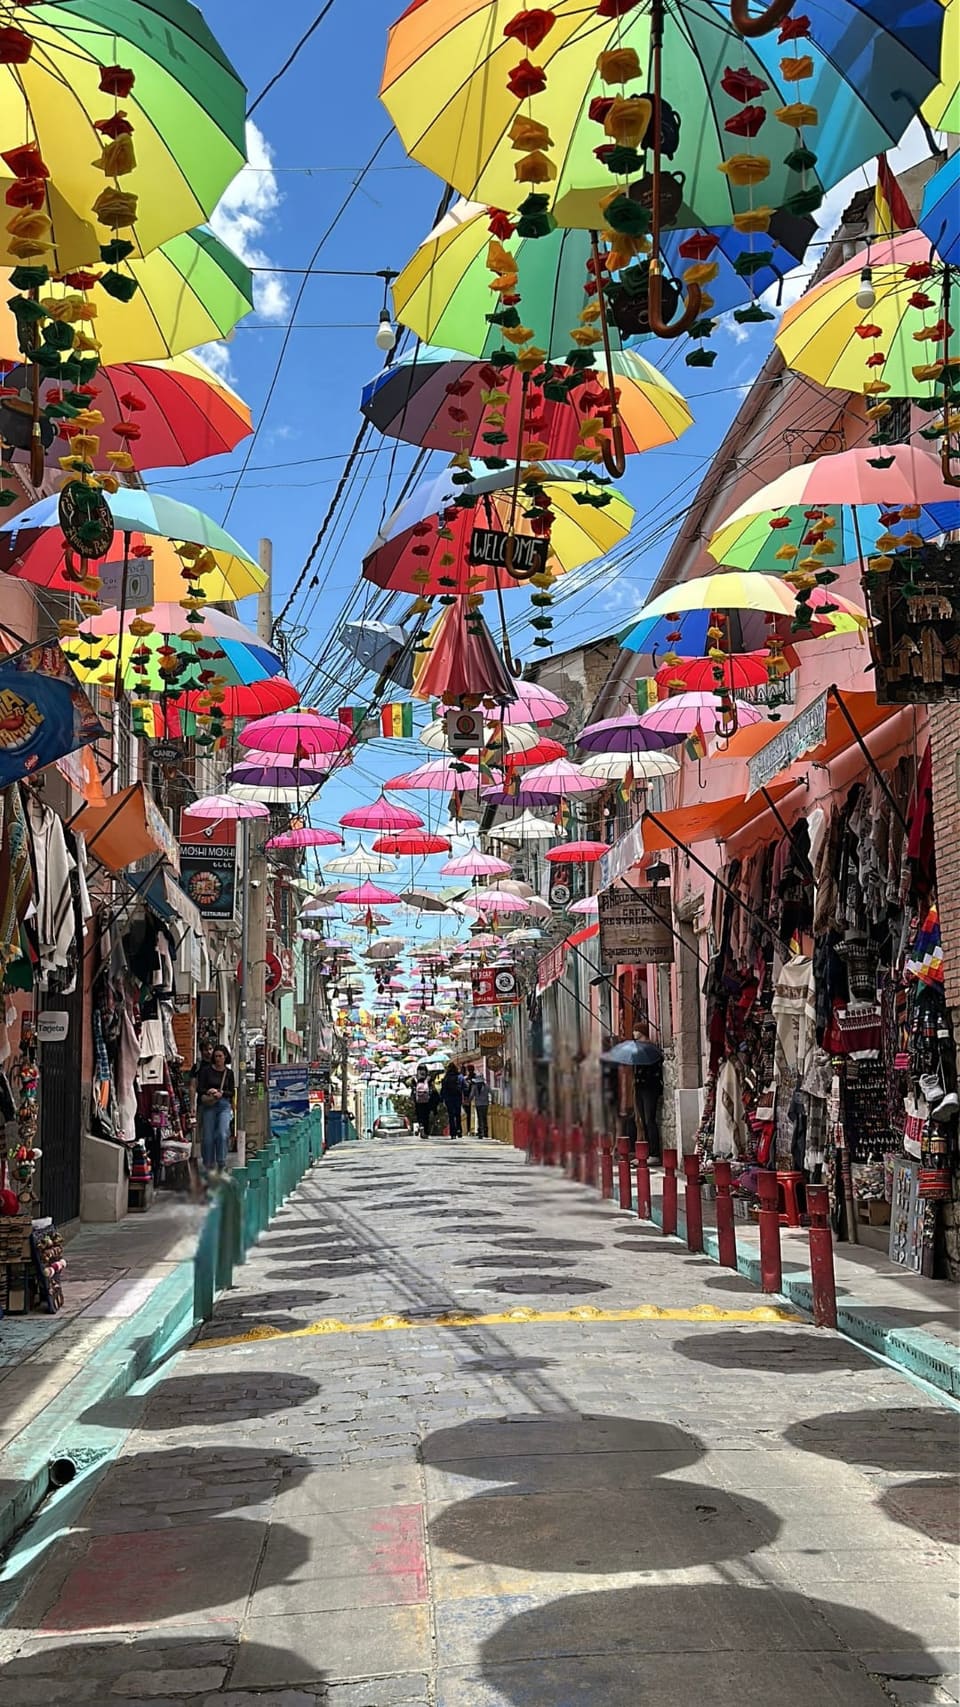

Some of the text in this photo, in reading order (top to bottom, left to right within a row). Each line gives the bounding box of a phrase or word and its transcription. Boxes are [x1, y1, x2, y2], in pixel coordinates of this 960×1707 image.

[13, 706, 25, 717] TU
[153, 750, 178, 758] CANDY
[181, 846, 235, 857] MOSHI MOSHI
[603, 917, 663, 926] RESTAURAN
